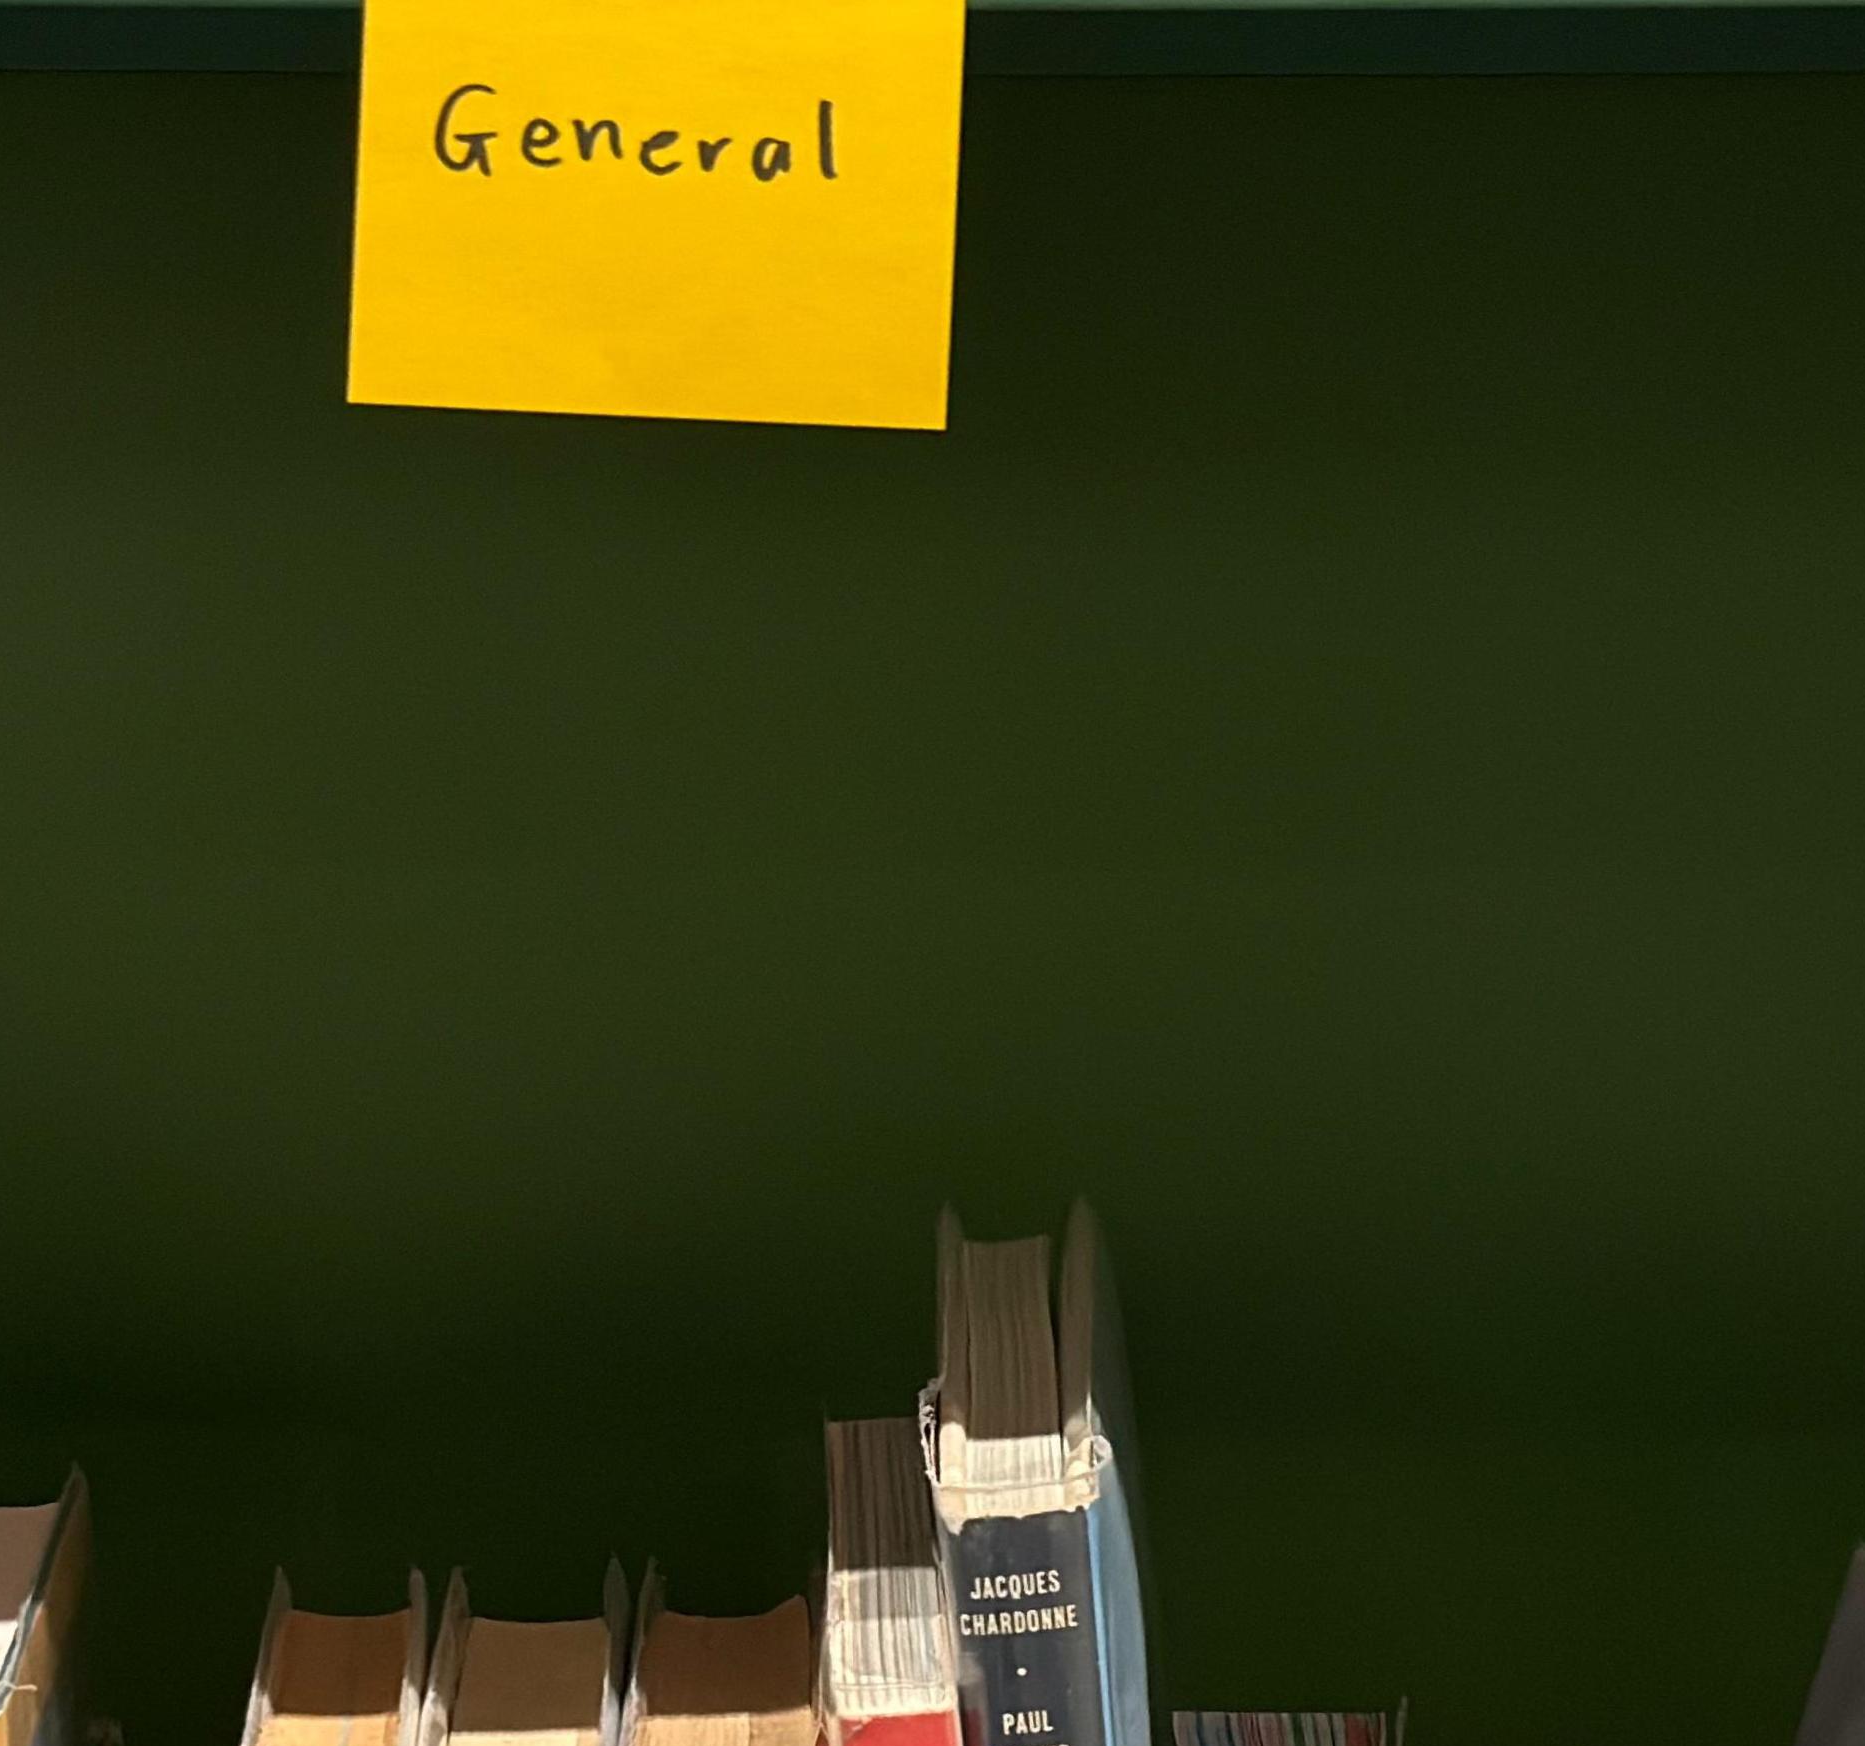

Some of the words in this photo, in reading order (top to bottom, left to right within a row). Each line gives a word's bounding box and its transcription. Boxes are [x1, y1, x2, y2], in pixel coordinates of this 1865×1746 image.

[434, 83, 838, 181] General
[969, 1569, 1061, 1601] JACQUES
[959, 1603, 1079, 1636] CHARDONNE
[1001, 1709, 1054, 1736] PAUL
